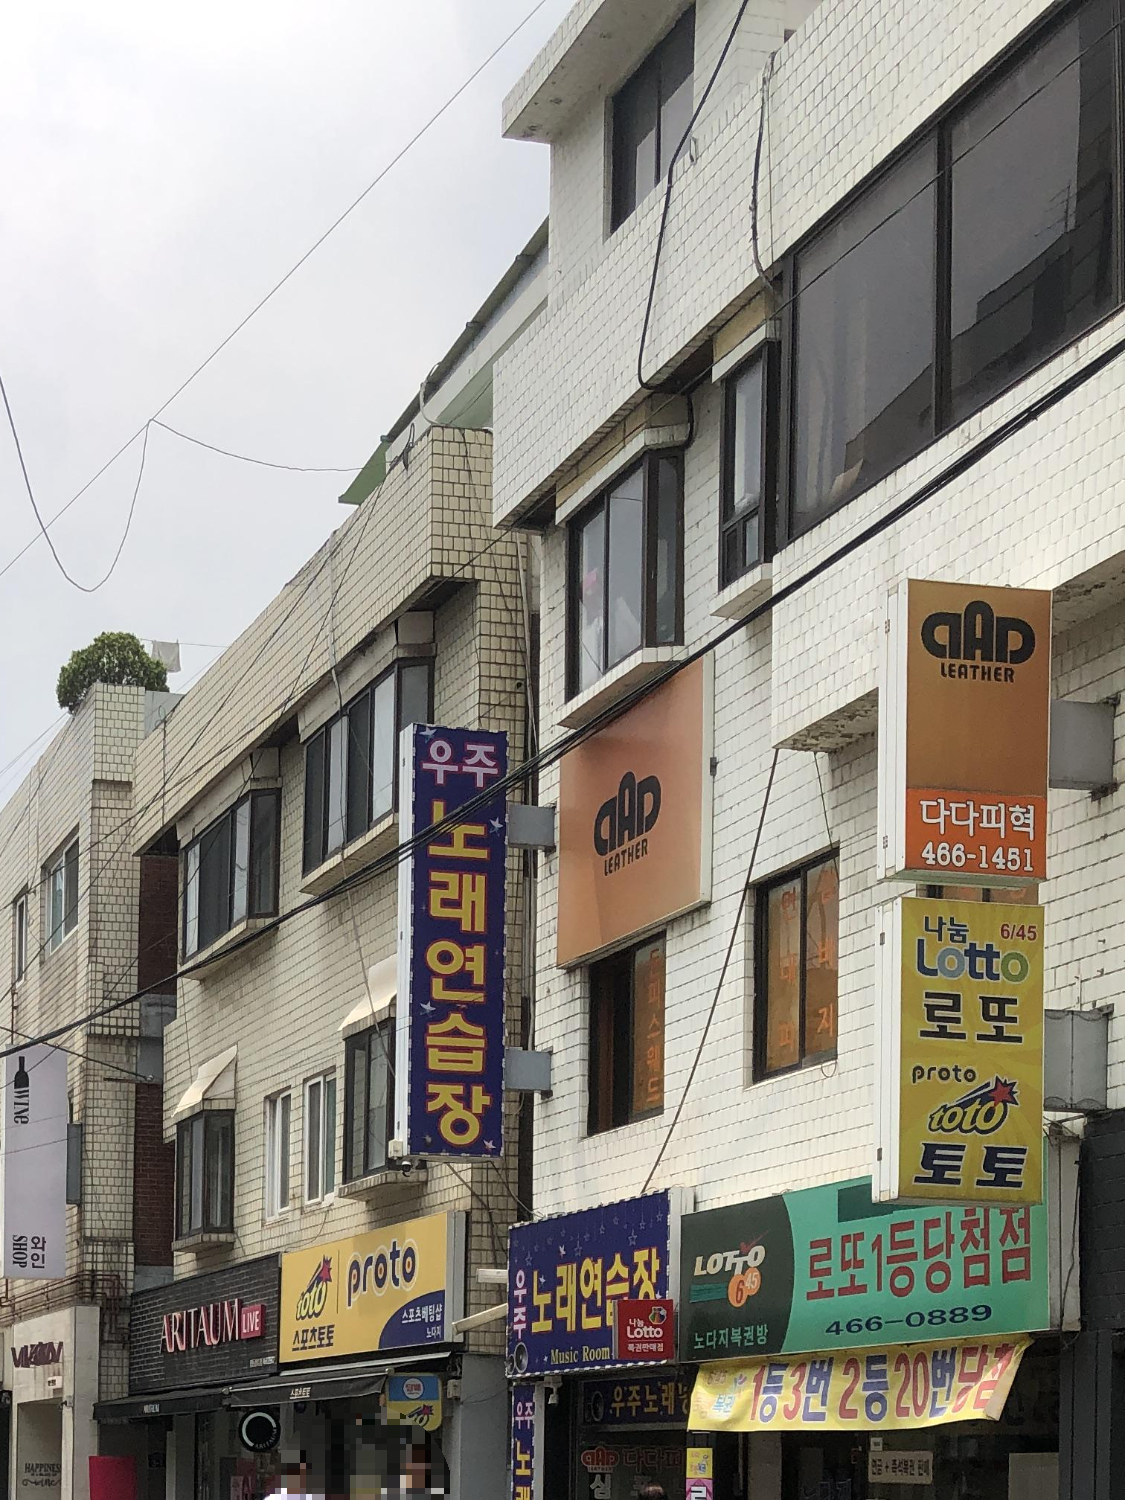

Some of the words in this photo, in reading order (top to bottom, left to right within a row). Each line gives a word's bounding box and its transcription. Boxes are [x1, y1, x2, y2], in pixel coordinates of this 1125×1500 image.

[940, 662, 1015, 683] LEATHER
[422, 739, 499, 788] 우주
[920, 797, 1036, 841] 다다피혁
[603, 838, 649, 876] LEATHER
[921, 841, 1034, 872] 466-1451
[924, 916, 969, 944] 나눔
[1000, 922, 1038, 942] 6/45
[424, 800, 491, 1147] 노래연습장
[916, 938, 1030, 983] Lotto
[911, 1064, 977, 1084] proto
[928, 1101, 1009, 1135] toto
[913, 1142, 1028, 1189] 토토
[12, 1234, 28, 1268] SHOP
[30, 1235, 47, 1269] 와인
[693, 1245, 766, 1277] LOTTO
[806, 1206, 1031, 1301] 로또1등당첨점
[346, 1239, 418, 1308] proto
[745, 1272, 759, 1289] 45
[295, 1282, 328, 1321] toto
[513, 1269, 527, 1340] 우주
[735, 1283, 745, 1304] 6
[159, 1298, 241, 1354] ARITAUM
[242, 1310, 260, 1334] LIVE
[426, 1325, 442, 1339] 노다지
[626, 1324, 664, 1339] Lotto
[825, 1304, 993, 1336] 466-0889
[292, 1324, 335, 1352] 스포츠토토
[693, 1325, 769, 1350] 노다지복권방
[550, 1348, 579, 1365] Music
[582, 1346, 611, 1363] Room
[515, 1401, 535, 1430] 우주
